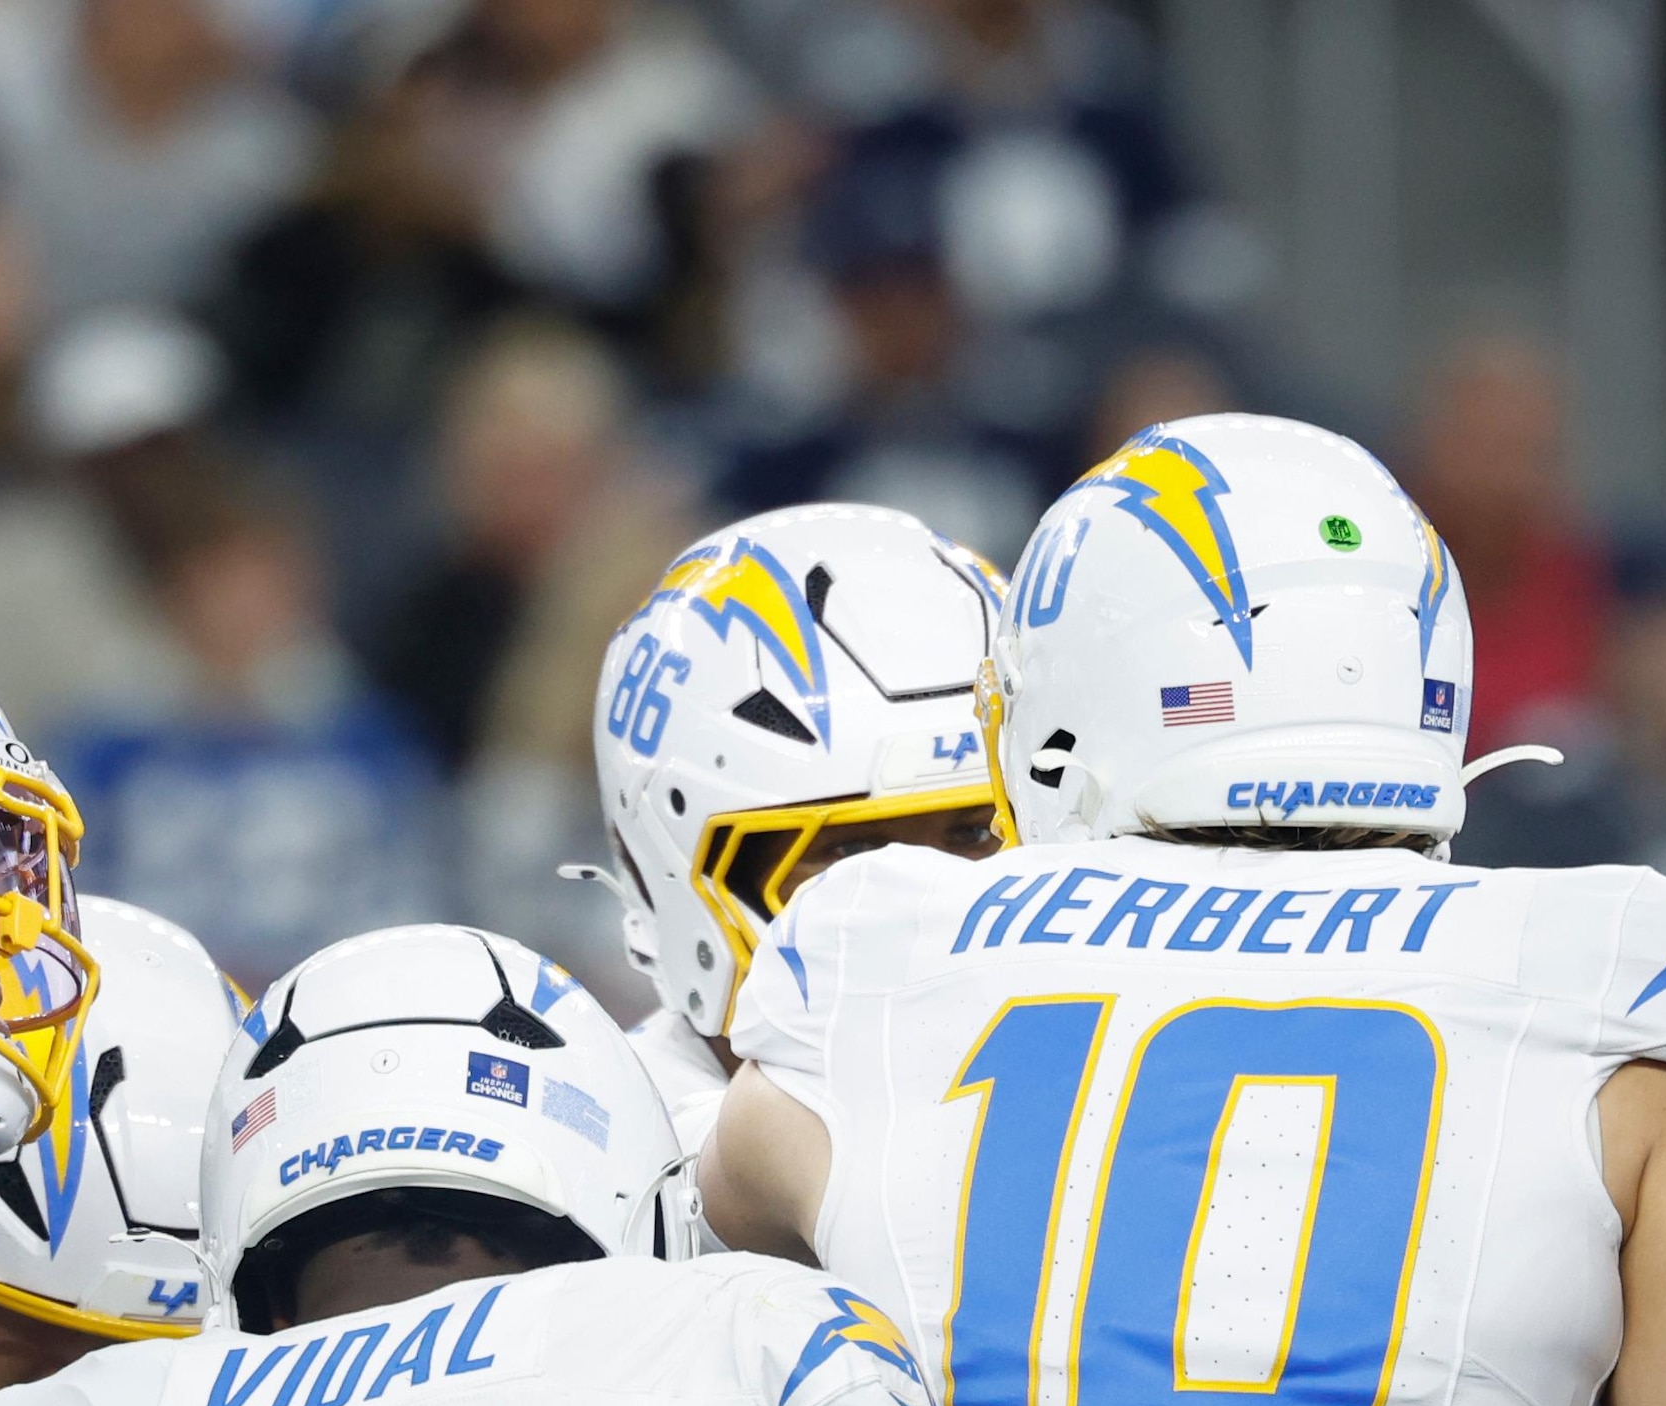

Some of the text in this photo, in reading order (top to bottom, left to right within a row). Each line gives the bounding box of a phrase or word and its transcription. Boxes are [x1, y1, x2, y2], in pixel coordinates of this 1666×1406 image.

[1013, 517, 1092, 634] 10
[608, 632, 691, 759] 86
[933, 732, 980, 769] LA
[1228, 781, 1440, 820] CHARGERS
[950, 867, 1481, 955] HERBERT
[471, 1081, 524, 1104] CHANGE
[279, 1126, 505, 1187] CHARGERS
[150, 1278, 199, 1316] LA
